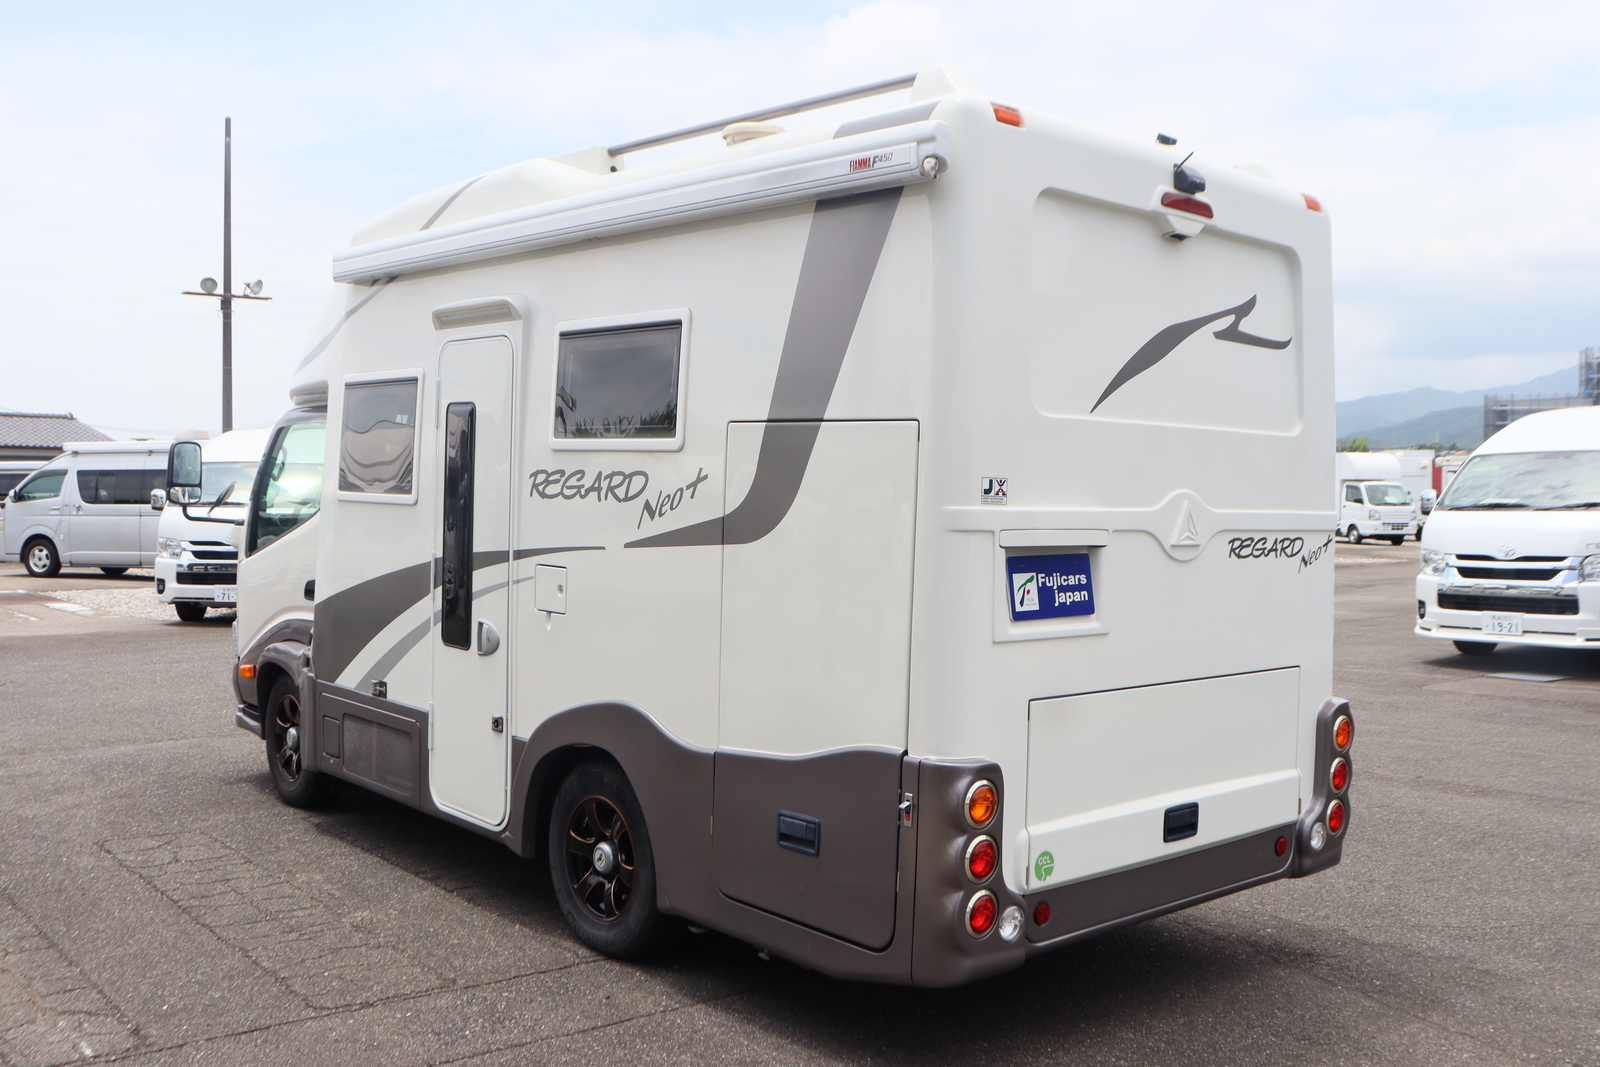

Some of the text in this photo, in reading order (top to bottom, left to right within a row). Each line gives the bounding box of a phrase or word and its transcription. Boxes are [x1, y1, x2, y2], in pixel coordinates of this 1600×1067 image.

[849, 156, 871, 173] FIAMMA
[528, 468, 650, 504] REGARD
[1227, 536, 1304, 559] REGARD
[1037, 572, 1088, 590] Fujicars
[1054, 590, 1089, 607] japan
[1038, 855, 1051, 866] CCL
